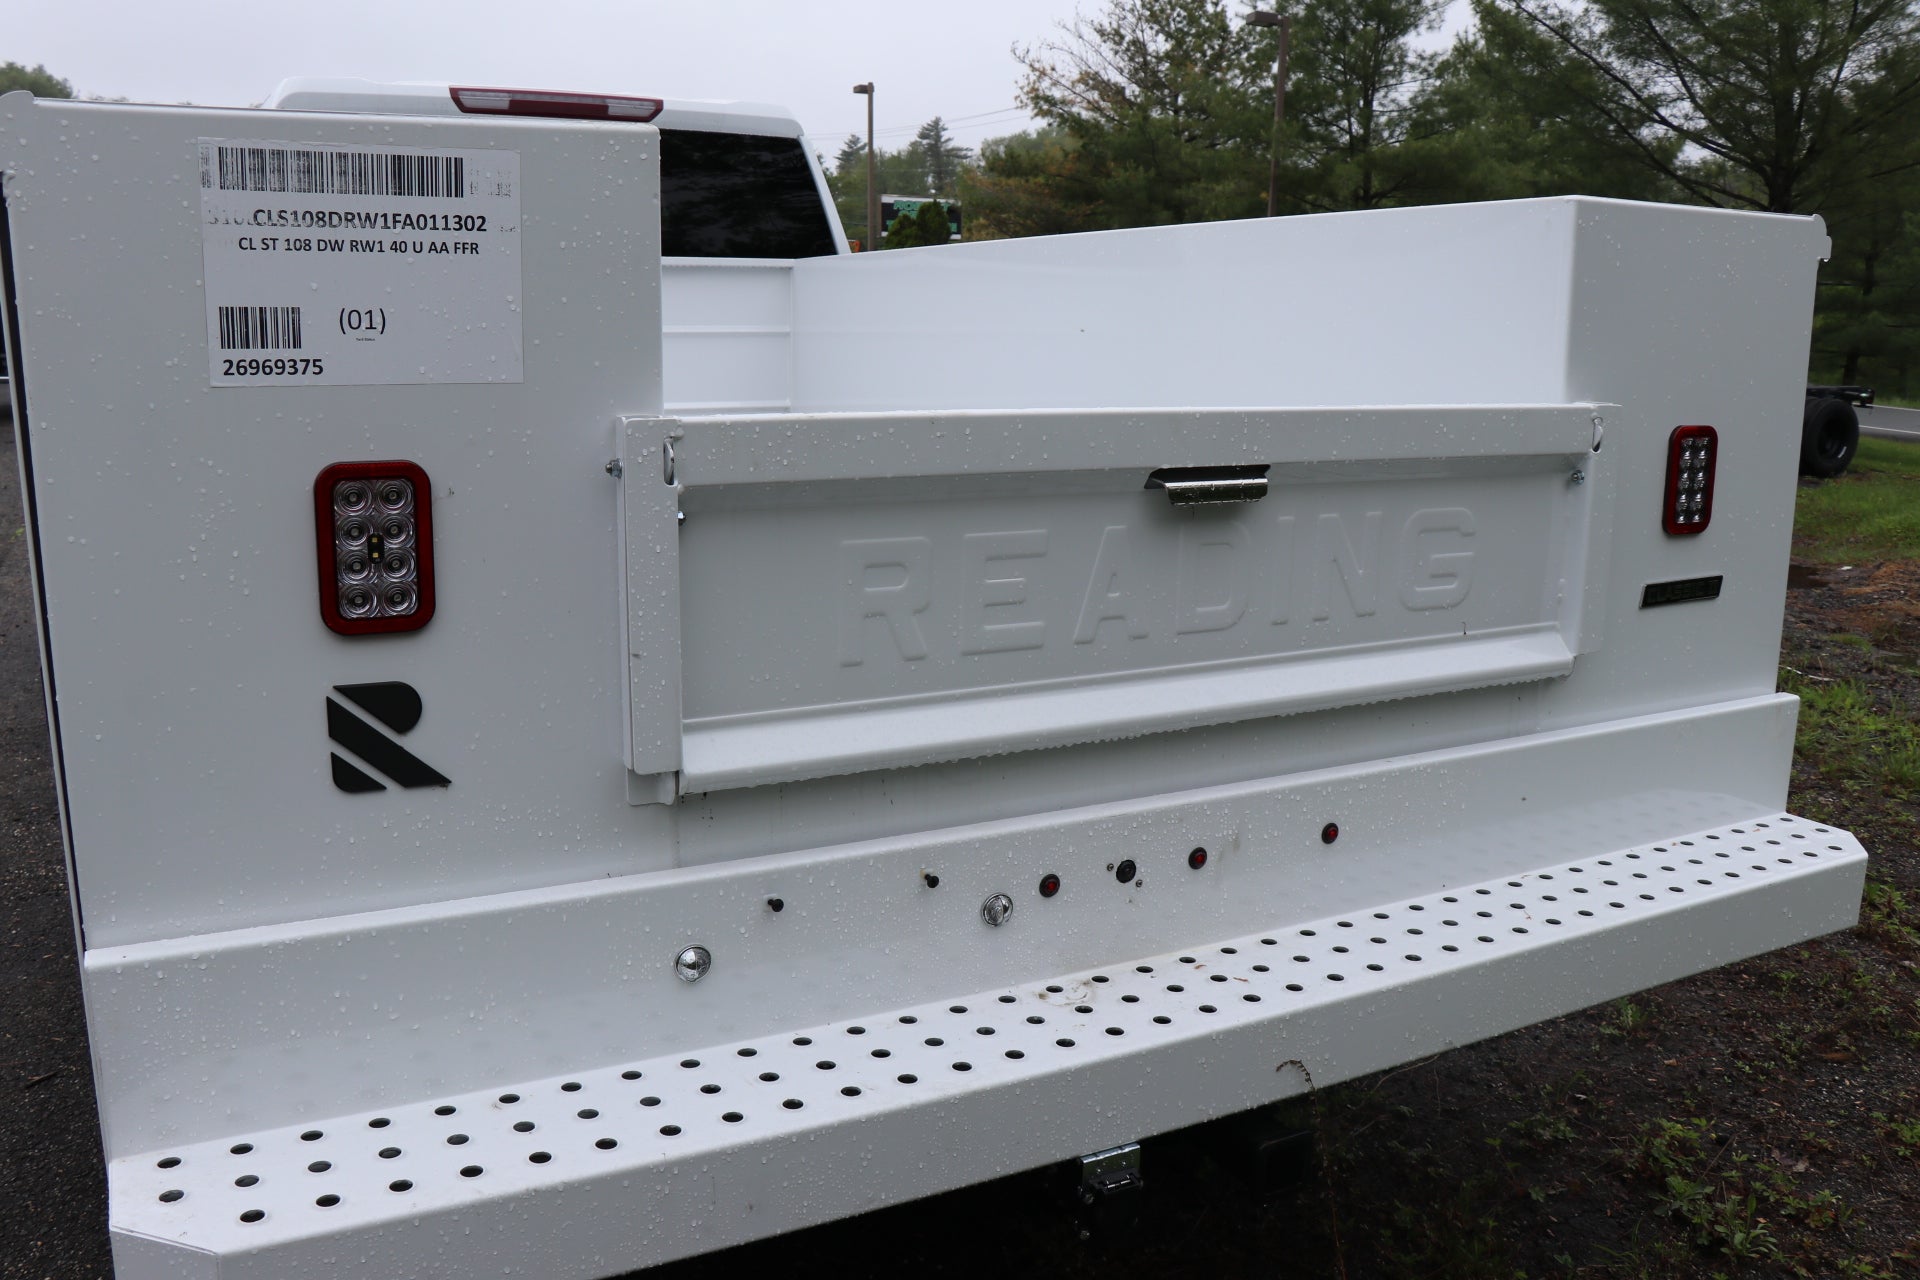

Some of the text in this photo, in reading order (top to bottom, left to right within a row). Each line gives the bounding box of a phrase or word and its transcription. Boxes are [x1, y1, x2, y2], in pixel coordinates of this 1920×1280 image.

[252, 209, 488, 232] CLS108DRW1FA011302
[238, 237, 480, 255] CL ST 108 DW RW1 40 U AA FFR
[339, 308, 387, 335] (01)
[222, 358, 324, 376] 26969375
[839, 506, 1478, 670] READING
